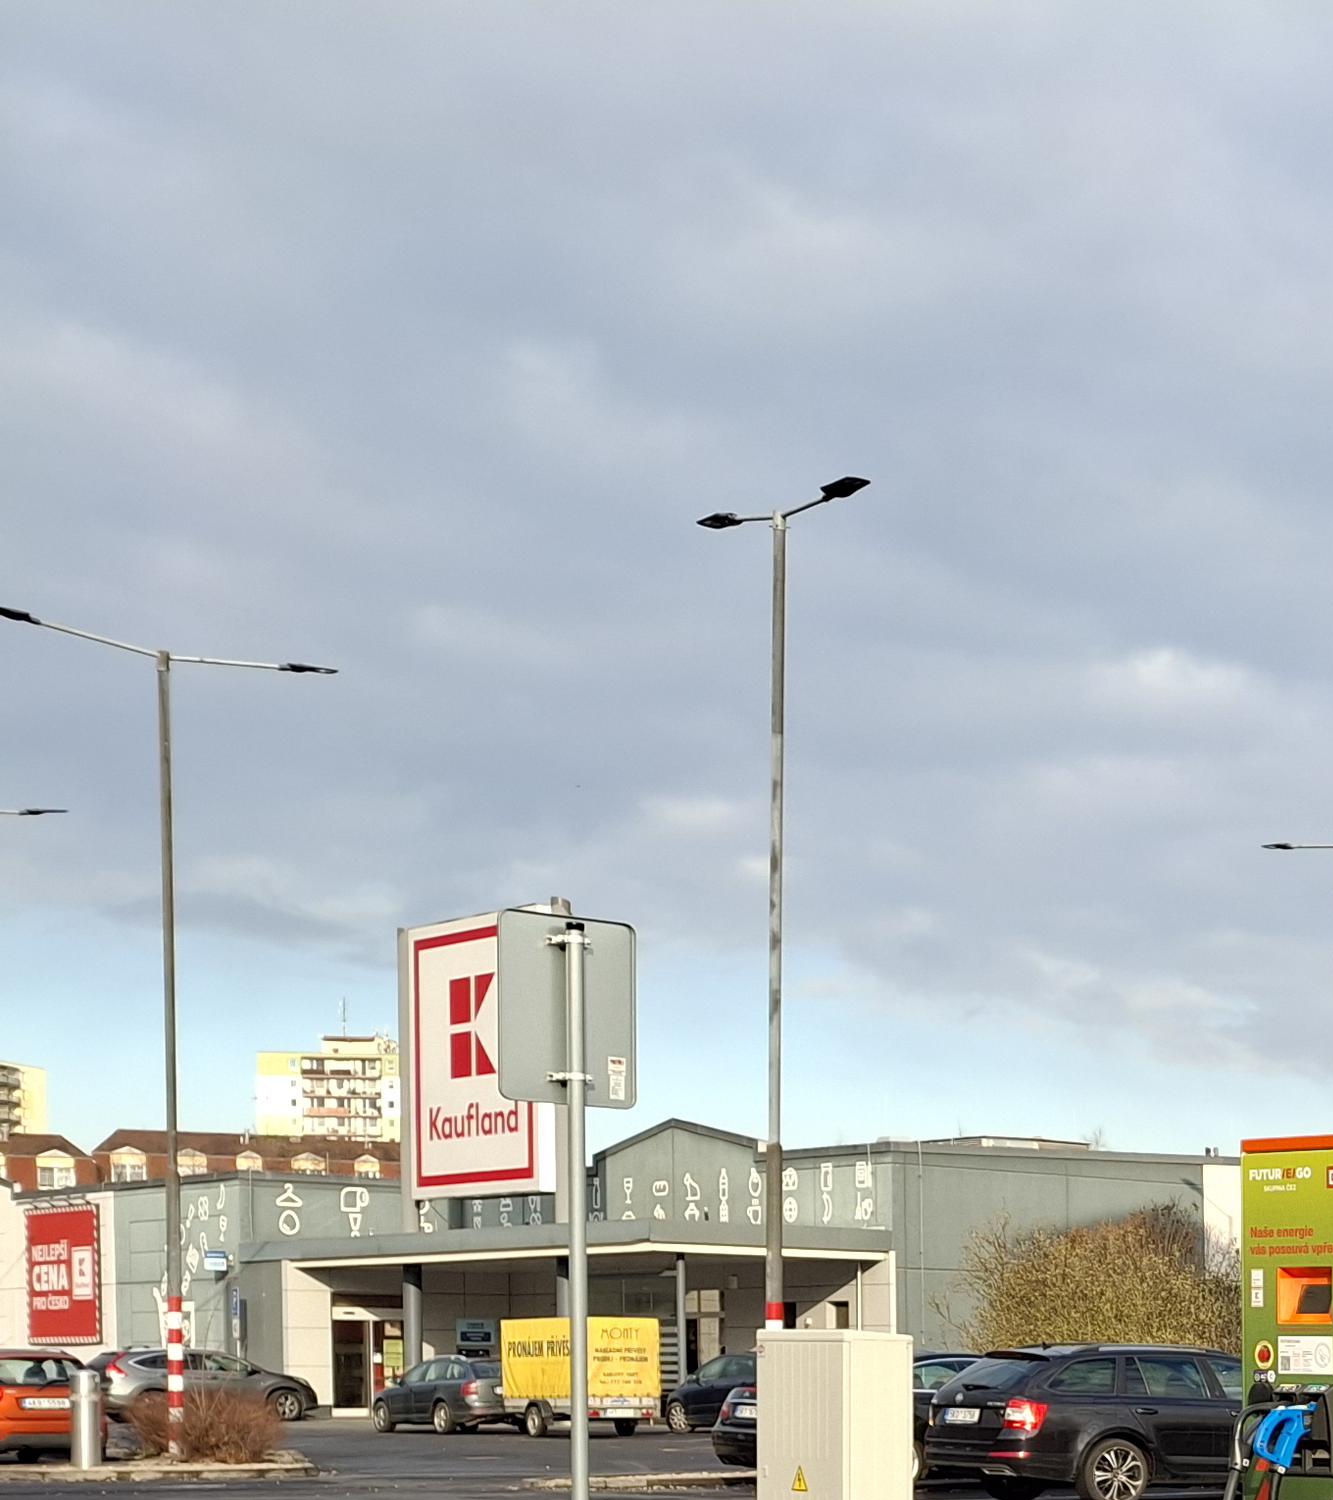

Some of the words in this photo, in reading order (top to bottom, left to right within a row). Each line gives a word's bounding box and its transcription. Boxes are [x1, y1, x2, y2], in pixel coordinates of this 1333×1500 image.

[428, 1101, 519, 1141] Kaufland
[1250, 1225, 1275, 1239] Naše
[1276, 1225, 1314, 1240] energie
[31, 1239, 68, 1262] NEJLEPŠÍ
[32, 1263, 69, 1292] CENA
[32, 1297, 47, 1310] PRO
[47, 1293, 70, 1310] ČESKO
[508, 1336, 544, 1358] PRONÁJEM
[546, 1335, 571, 1357] PŘÍVĚS
